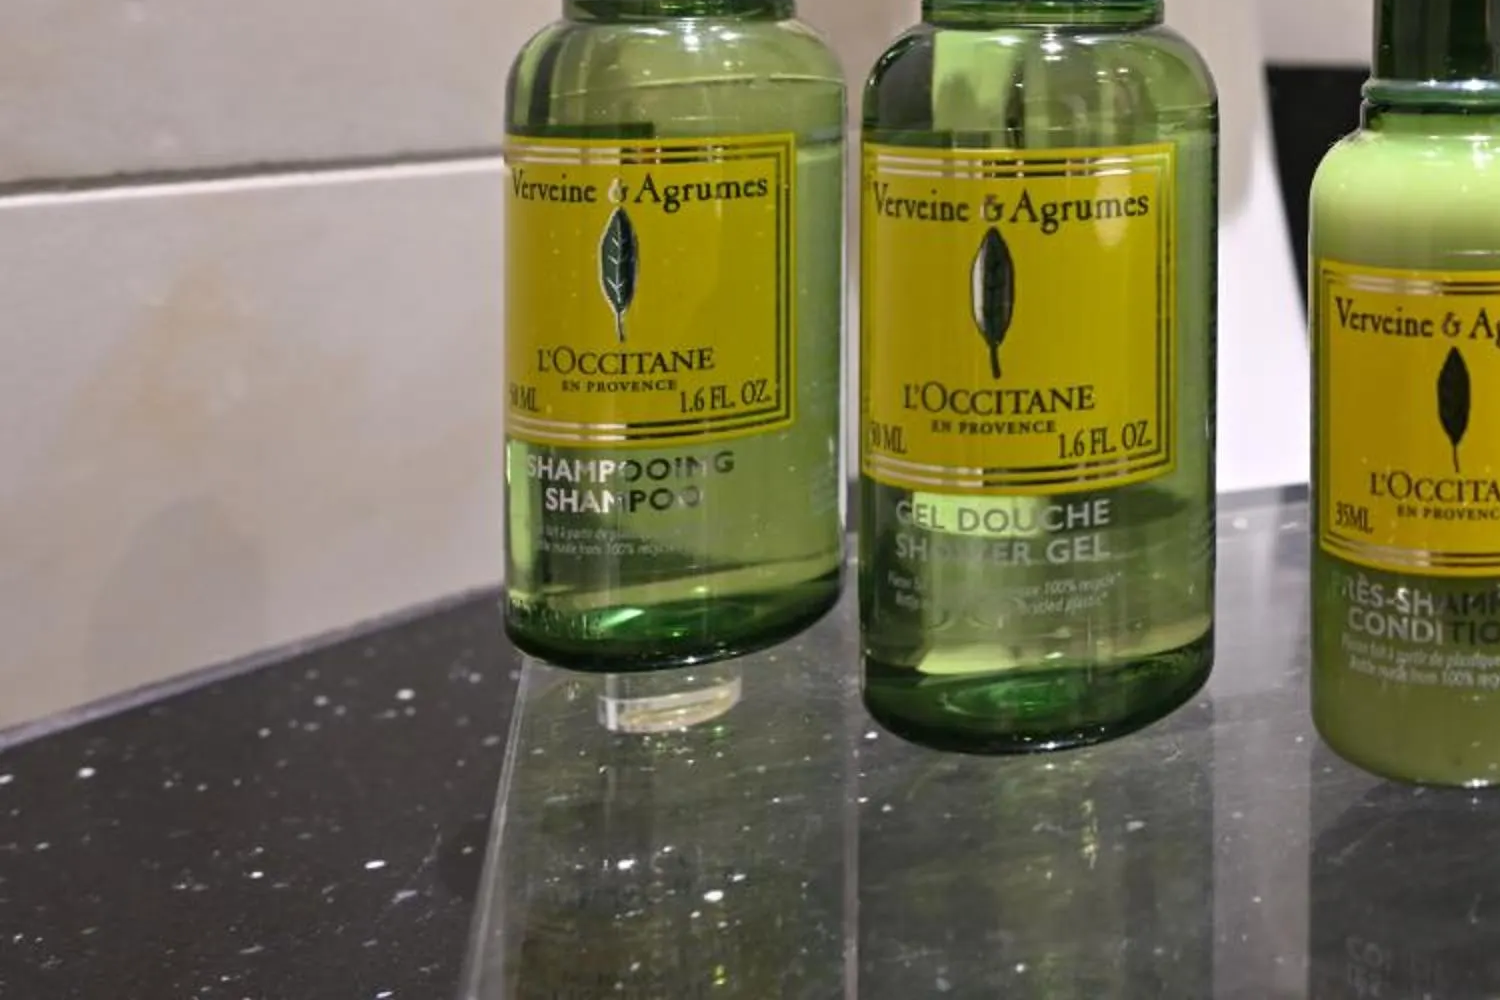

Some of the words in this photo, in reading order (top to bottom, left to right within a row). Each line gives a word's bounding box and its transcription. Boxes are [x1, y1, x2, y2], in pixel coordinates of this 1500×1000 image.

[511, 168, 597, 203] Verveine
[634, 173, 768, 213] Agrumes
[873, 181, 970, 222] Verveine
[1009, 188, 1150, 235] Agrumes
[1335, 297, 1434, 338] Verveine
[1441, 311, 1462, 337] &
[537, 345, 715, 375] L'OCCITANE
[562, 380, 581, 392] EN
[587, 379, 677, 393] PROVENCE
[903, 381, 1096, 416] L'OCCITANE
[931, 419, 951, 433] EN
[958, 419, 1056, 435] PROVENCE
[895, 500, 945, 530] GEL
[957, 499, 1112, 532] DOUCHE
[1397, 504, 1418, 518] EN
[1045, 534, 1111, 564] GEL
